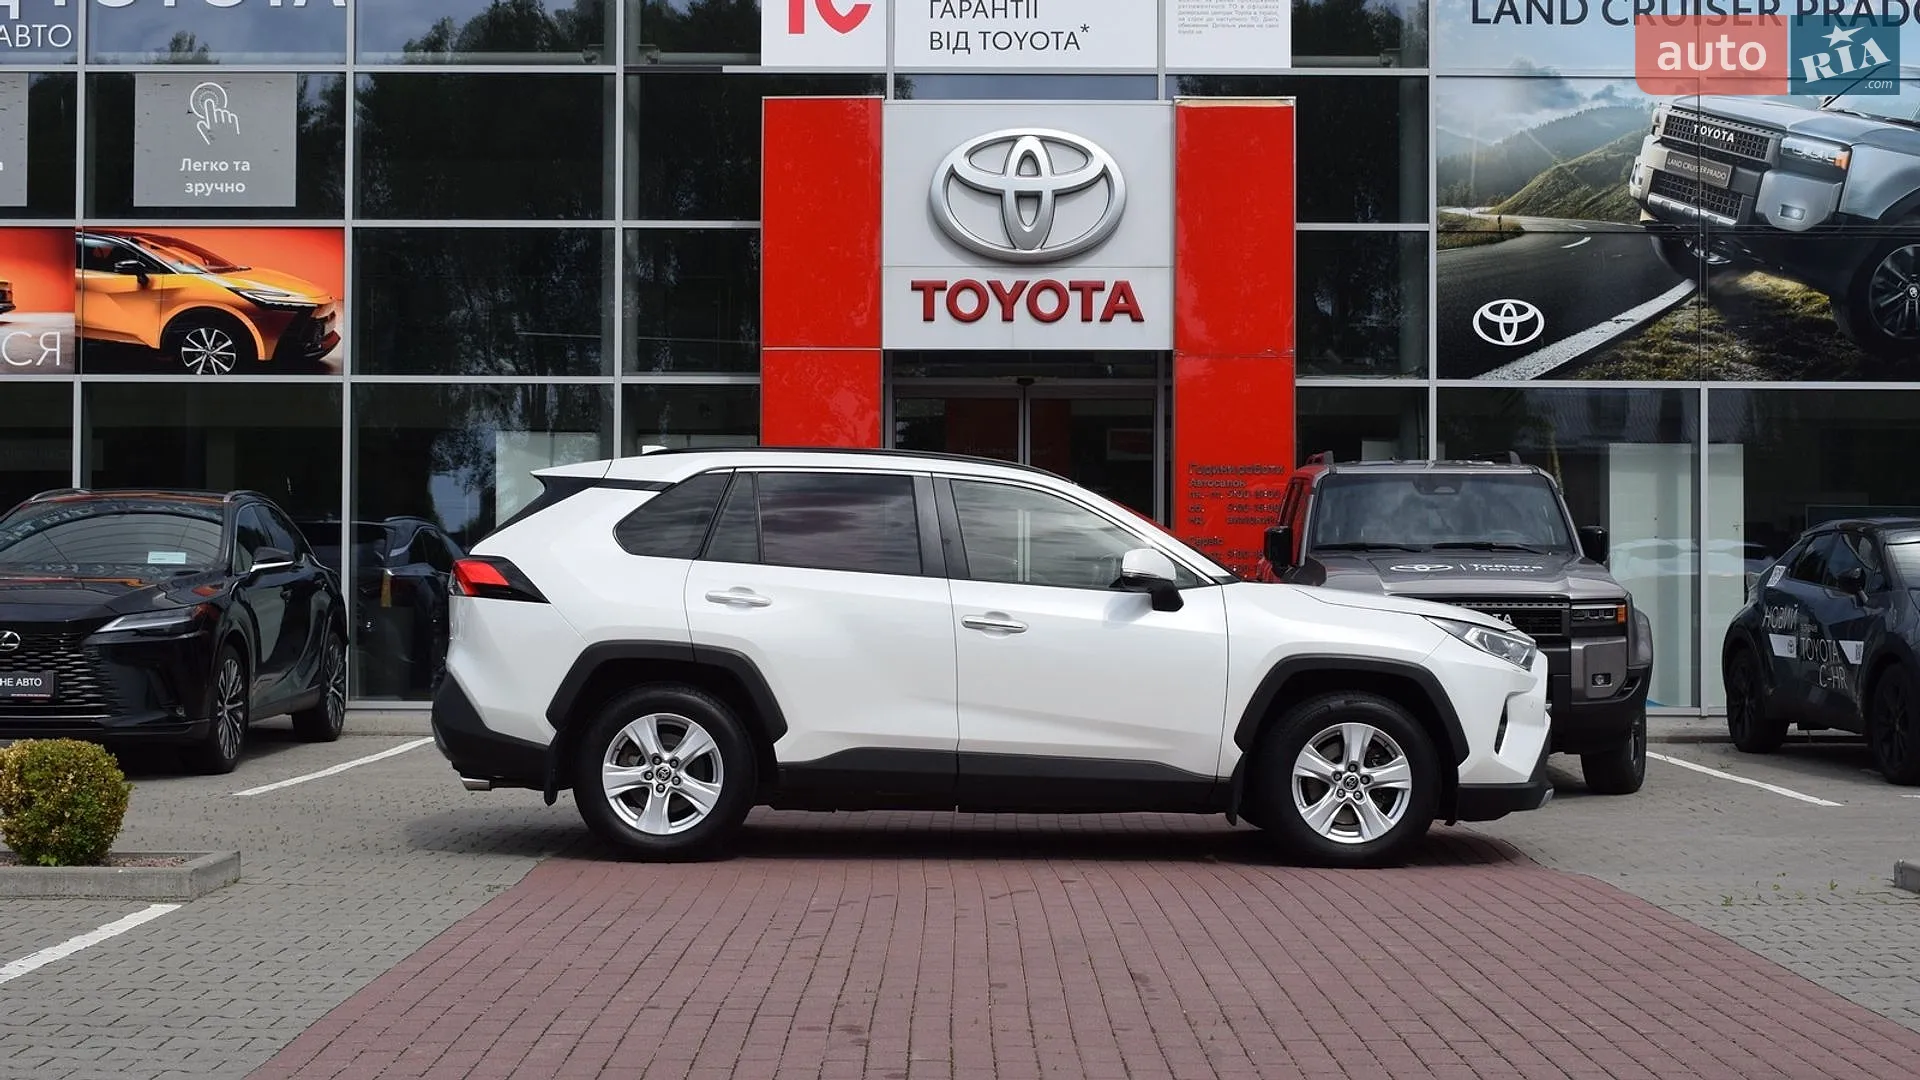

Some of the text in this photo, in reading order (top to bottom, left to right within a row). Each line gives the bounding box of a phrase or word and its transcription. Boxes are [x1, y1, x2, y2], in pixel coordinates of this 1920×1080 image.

[1472, 0, 1920, 27] LAND CRUISER PRAD
[930, 31, 971, 54] ВІД
[1693, 124, 1734, 143] TOYOTA
[180, 158, 250, 172] Легко та
[1667, 158, 1682, 168] LAND
[184, 182, 246, 196] зручно
[911, 279, 1145, 323] TOYOTA
[1, 331, 61, 366] СЯ
[1762, 603, 1798, 629] НОВИЙ
[1800, 637, 1840, 662] TOYOTA
[15, 677, 42, 687] АВТО
[1820, 665, 1848, 689] C-HR
